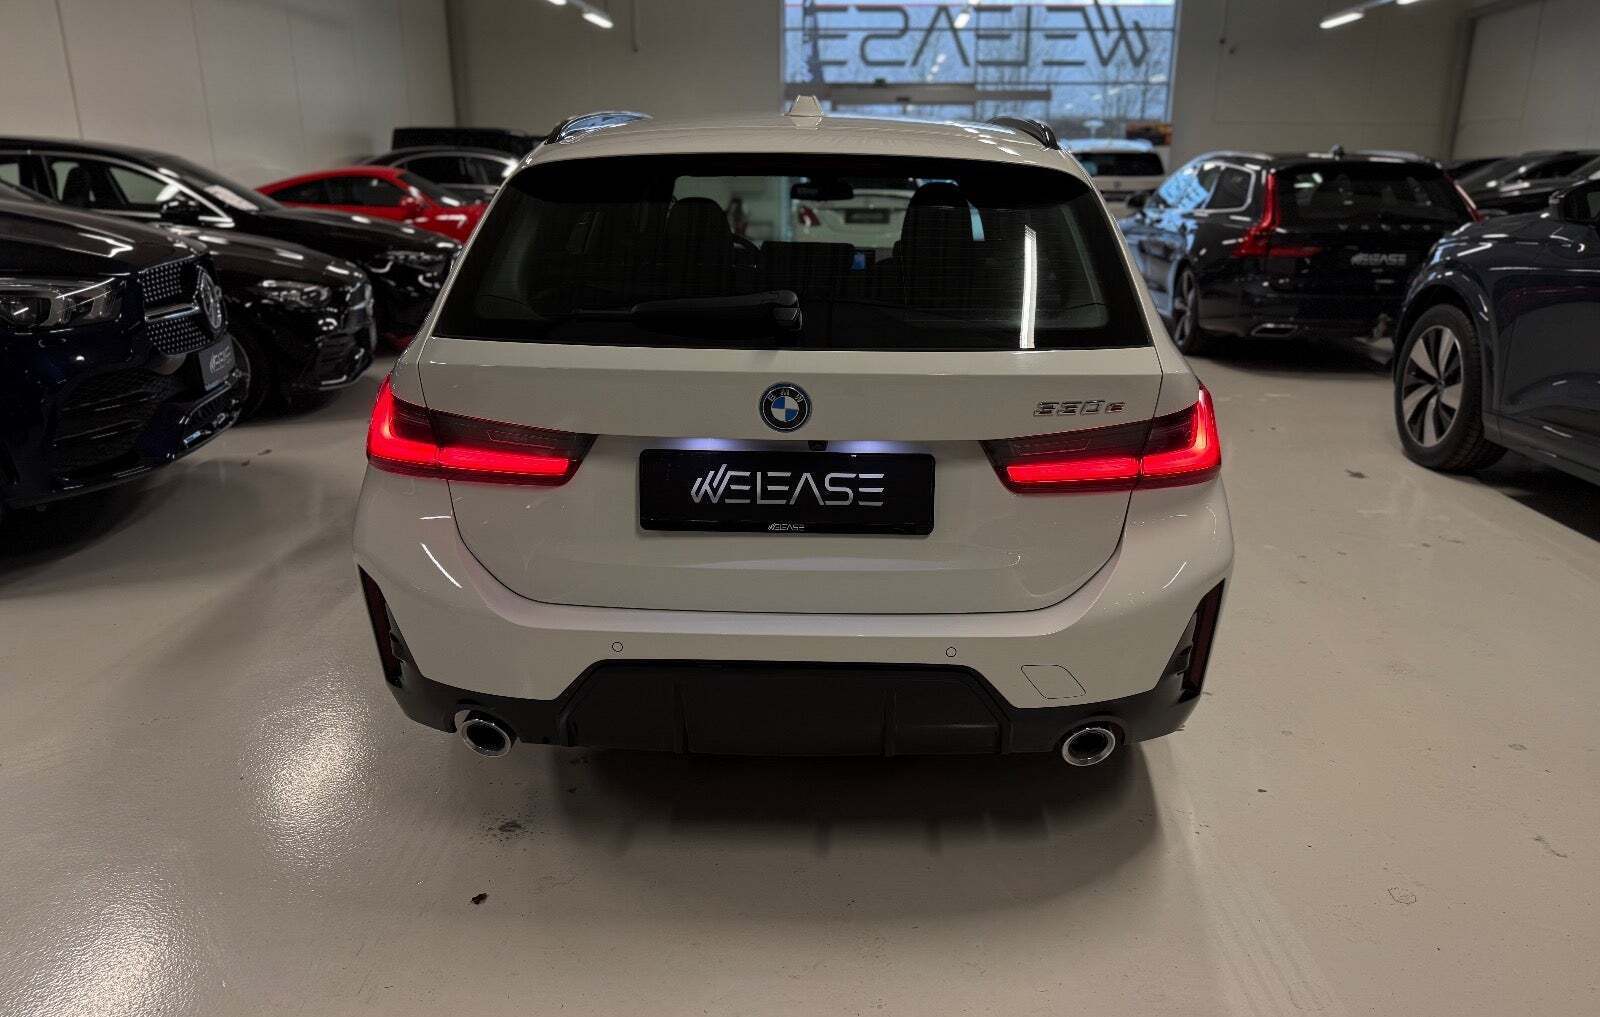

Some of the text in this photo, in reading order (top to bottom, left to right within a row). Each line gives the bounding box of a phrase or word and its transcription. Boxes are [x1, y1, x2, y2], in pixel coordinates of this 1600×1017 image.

[767, 388, 805, 403] BMW
[690, 463, 885, 507] WELEASE
[767, 522, 806, 532] WELEASE
